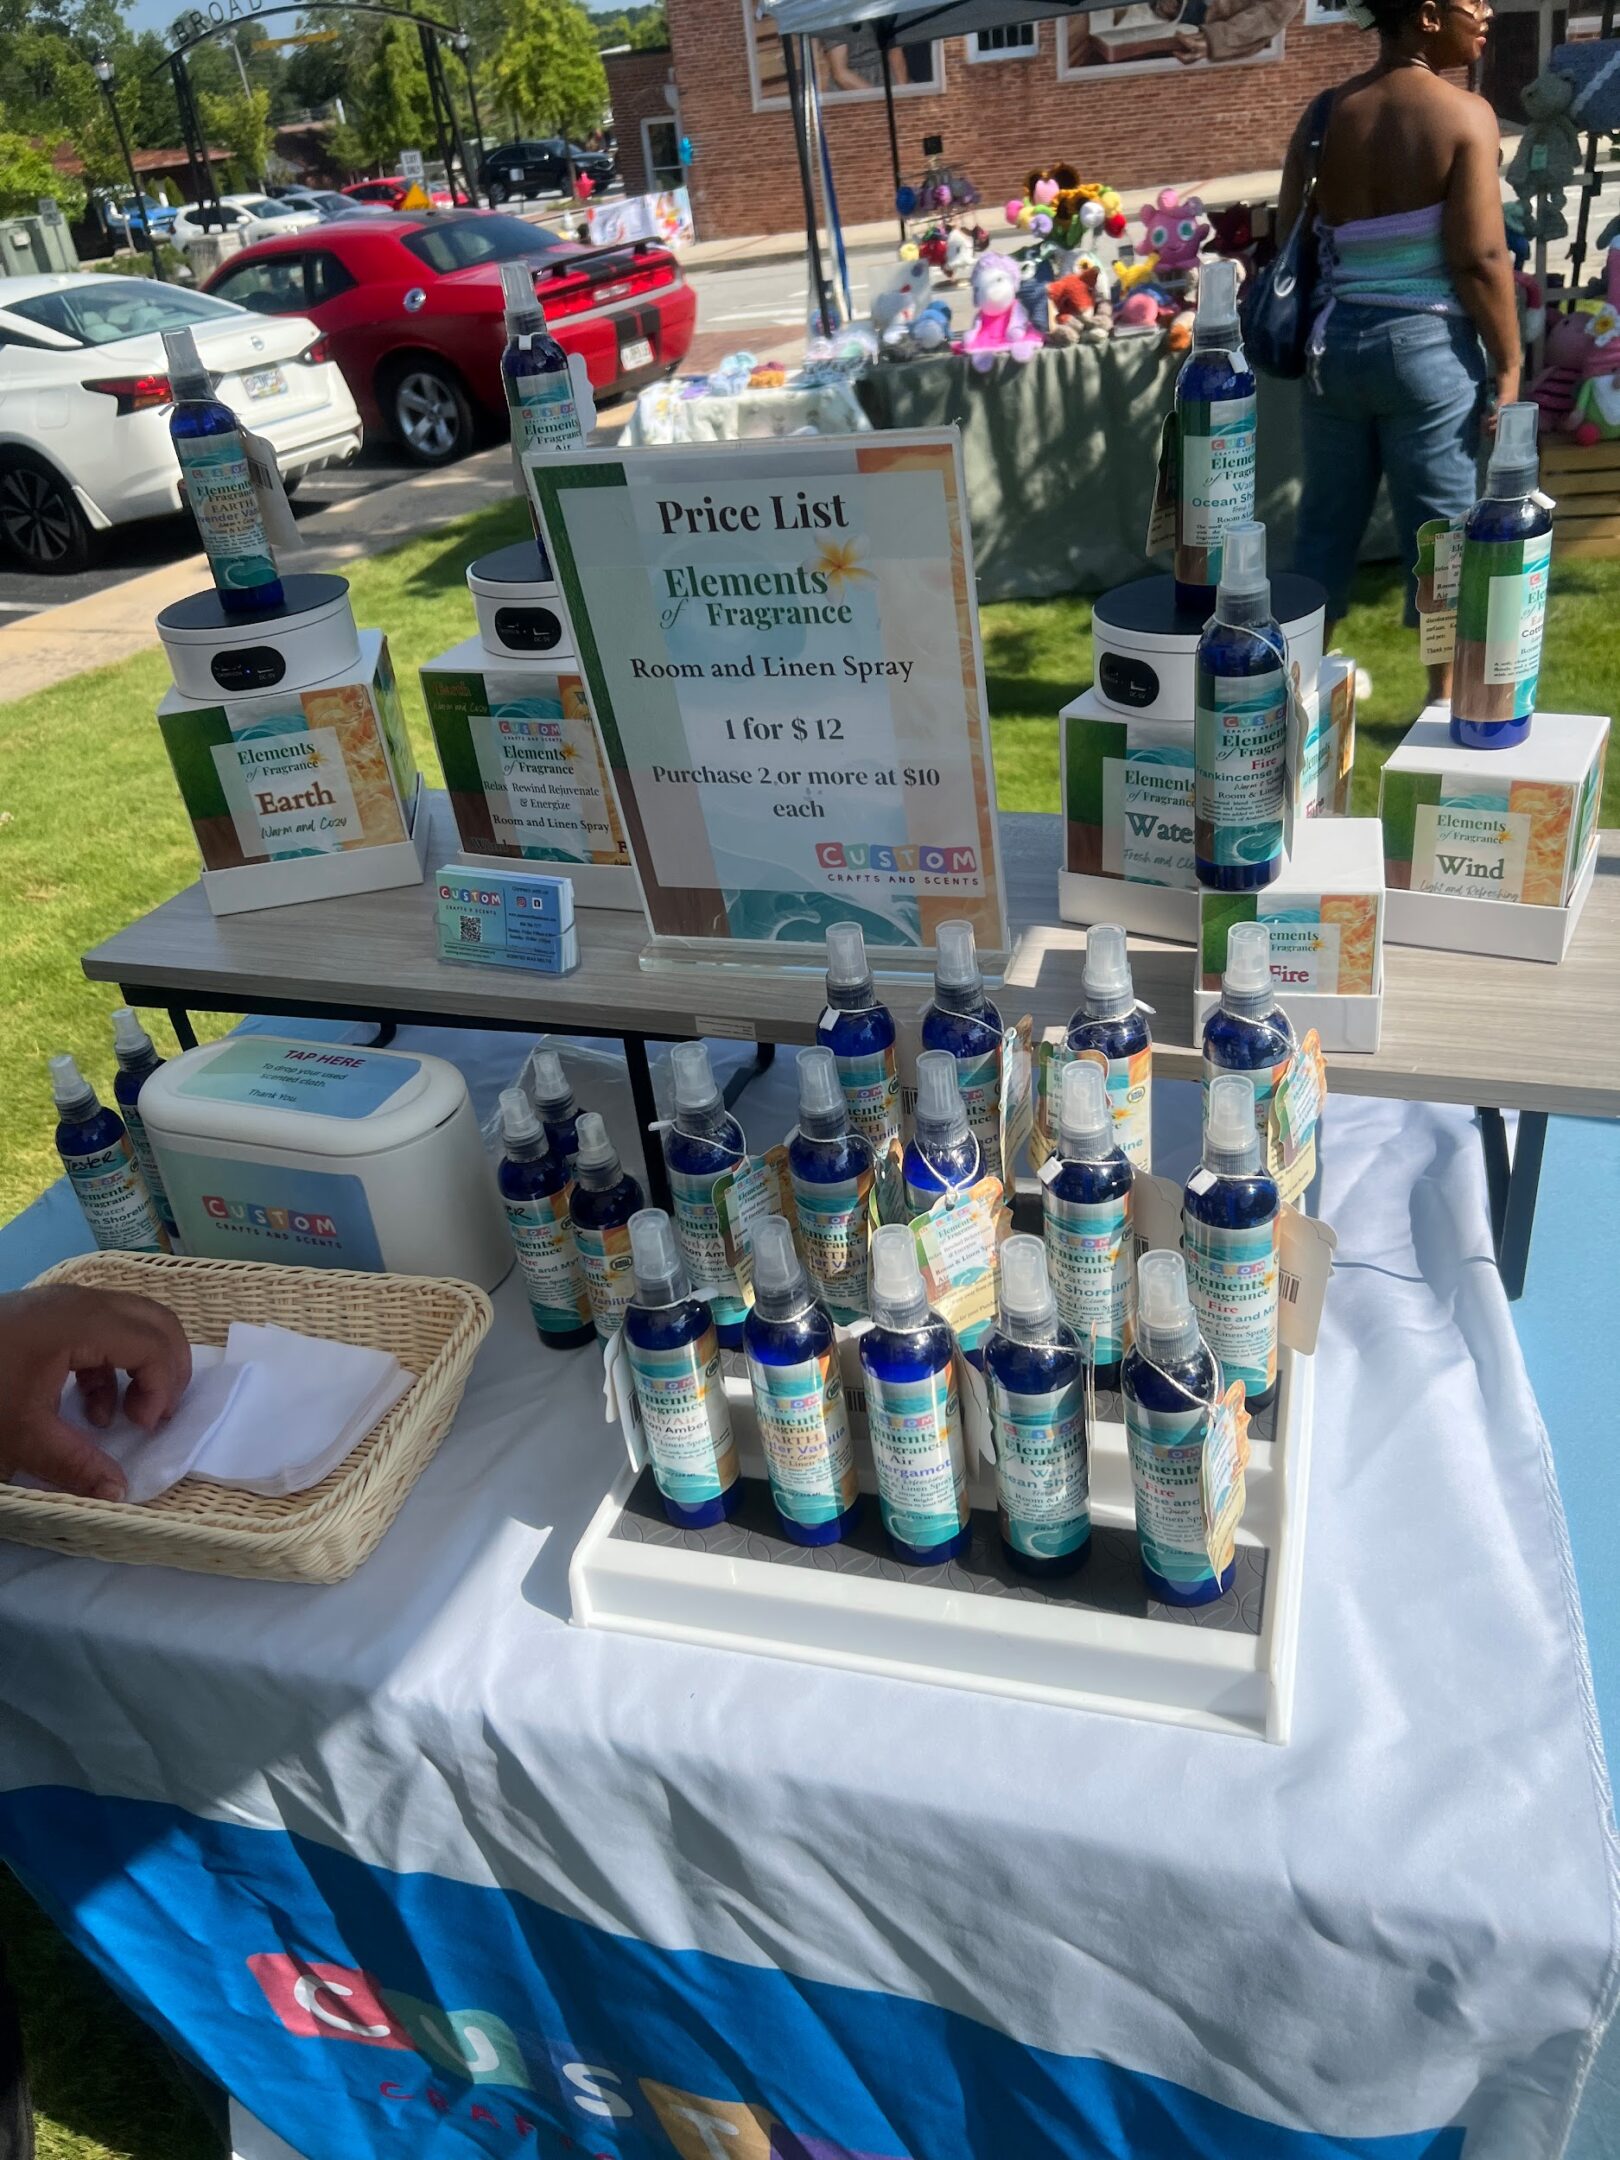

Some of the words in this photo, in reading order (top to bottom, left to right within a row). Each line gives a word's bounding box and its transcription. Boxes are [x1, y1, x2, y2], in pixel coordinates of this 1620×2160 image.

[1192, 497, 1237, 508] Ocean
[656, 496, 761, 534] Price
[772, 491, 850, 530] List
[1217, 515, 1240, 523] Room
[663, 565, 829, 599] Elements
[659, 599, 687, 630] of
[705, 601, 853, 631] Fragrance
[629, 657, 703, 680] Room
[711, 656, 756, 679] and
[762, 655, 835, 678] Linen
[844, 656, 914, 683] Spray
[499, 721, 561, 737] CUSTOM
[725, 718, 737, 741] 1
[743, 716, 783, 741] for
[237, 742, 316, 765] Elements
[503, 745, 567, 761] Elements
[1216, 748, 1235, 761] of
[245, 767, 259, 783] of
[262, 760, 319, 776] Fragrance
[503, 760, 519, 775] of
[519, 762, 574, 776] Fragrance
[1252, 756, 1277, 770] Fire
[652, 765, 757, 786] Purchase
[778, 769, 802, 786] or
[808, 768, 869, 786] more
[875, 769, 898, 786] at
[904, 767, 941, 787] $10
[484, 780, 508, 792] Relax
[513, 782, 547, 794] Rewind
[549, 784, 600, 797] Rejuvenate
[1126, 790, 1142, 802] of
[1218, 791, 1246, 800] Room
[254, 781, 336, 816] Earth
[530, 799, 571, 811] Energize
[772, 799, 826, 819] each
[261, 827, 292, 839] Warm
[296, 820, 315, 833] and
[320, 816, 348, 830] Cozy
[493, 814, 525, 827] Room
[526, 817, 545, 828] and
[547, 818, 578, 830] Linen
[580, 818, 609, 833] Spray
[1437, 814, 1507, 832] Elements
[1439, 830, 1454, 841] of
[1454, 831, 1505, 845] Fragrance
[815, 842, 979, 873] CUSTOM
[1123, 848, 1151, 863] Fresh
[1153, 856, 1172, 868] and
[1436, 854, 1506, 880] Wind
[827, 873, 881, 884] CRAFTS
[888, 875, 918, 885] AND
[924, 877, 980, 887] SCENTS
[440, 886, 502, 905] CUSTOM
[1420, 880, 1444, 894] Light
[1445, 885, 1462, 895] and
[1467, 885, 1520, 903] Refreshing
[1271, 944, 1318, 953] Fragrance
[1269, 965, 1310, 983] Fire
[284, 1050, 317, 1061] TAP
[317, 1054, 366, 1069] HERE
[260, 1072, 299, 1085] scented
[262, 1062, 273, 1070] To
[274, 1064, 298, 1075] drop
[298, 1067, 321, 1077] your
[321, 1070, 348, 1081] used
[249, 1088, 278, 1100] Thank
[92, 1206, 127, 1217] Water
[202, 1196, 337, 1237] CUSTOM
[215, 1222, 260, 1235] CRAFTS
[265, 1229, 290, 1240] AND
[295, 1234, 343, 1249] SCENTS
[1056, 1268, 1097, 1286] Water
[1199, 1284, 1271, 1303] Fragrance
[1208, 1300, 1239, 1314] Fire
[1235, 1311, 1260, 1323] and
[1215, 1328, 1243, 1338] Linen
[665, 1421, 709, 1434] Amber
[797, 1426, 846, 1455] Vanilla
[877, 1456, 952, 1479] Bergamot
[890, 1455, 915, 1465] Air
[1144, 1480, 1175, 1498] Fire
[1173, 1498, 1200, 1507] and
